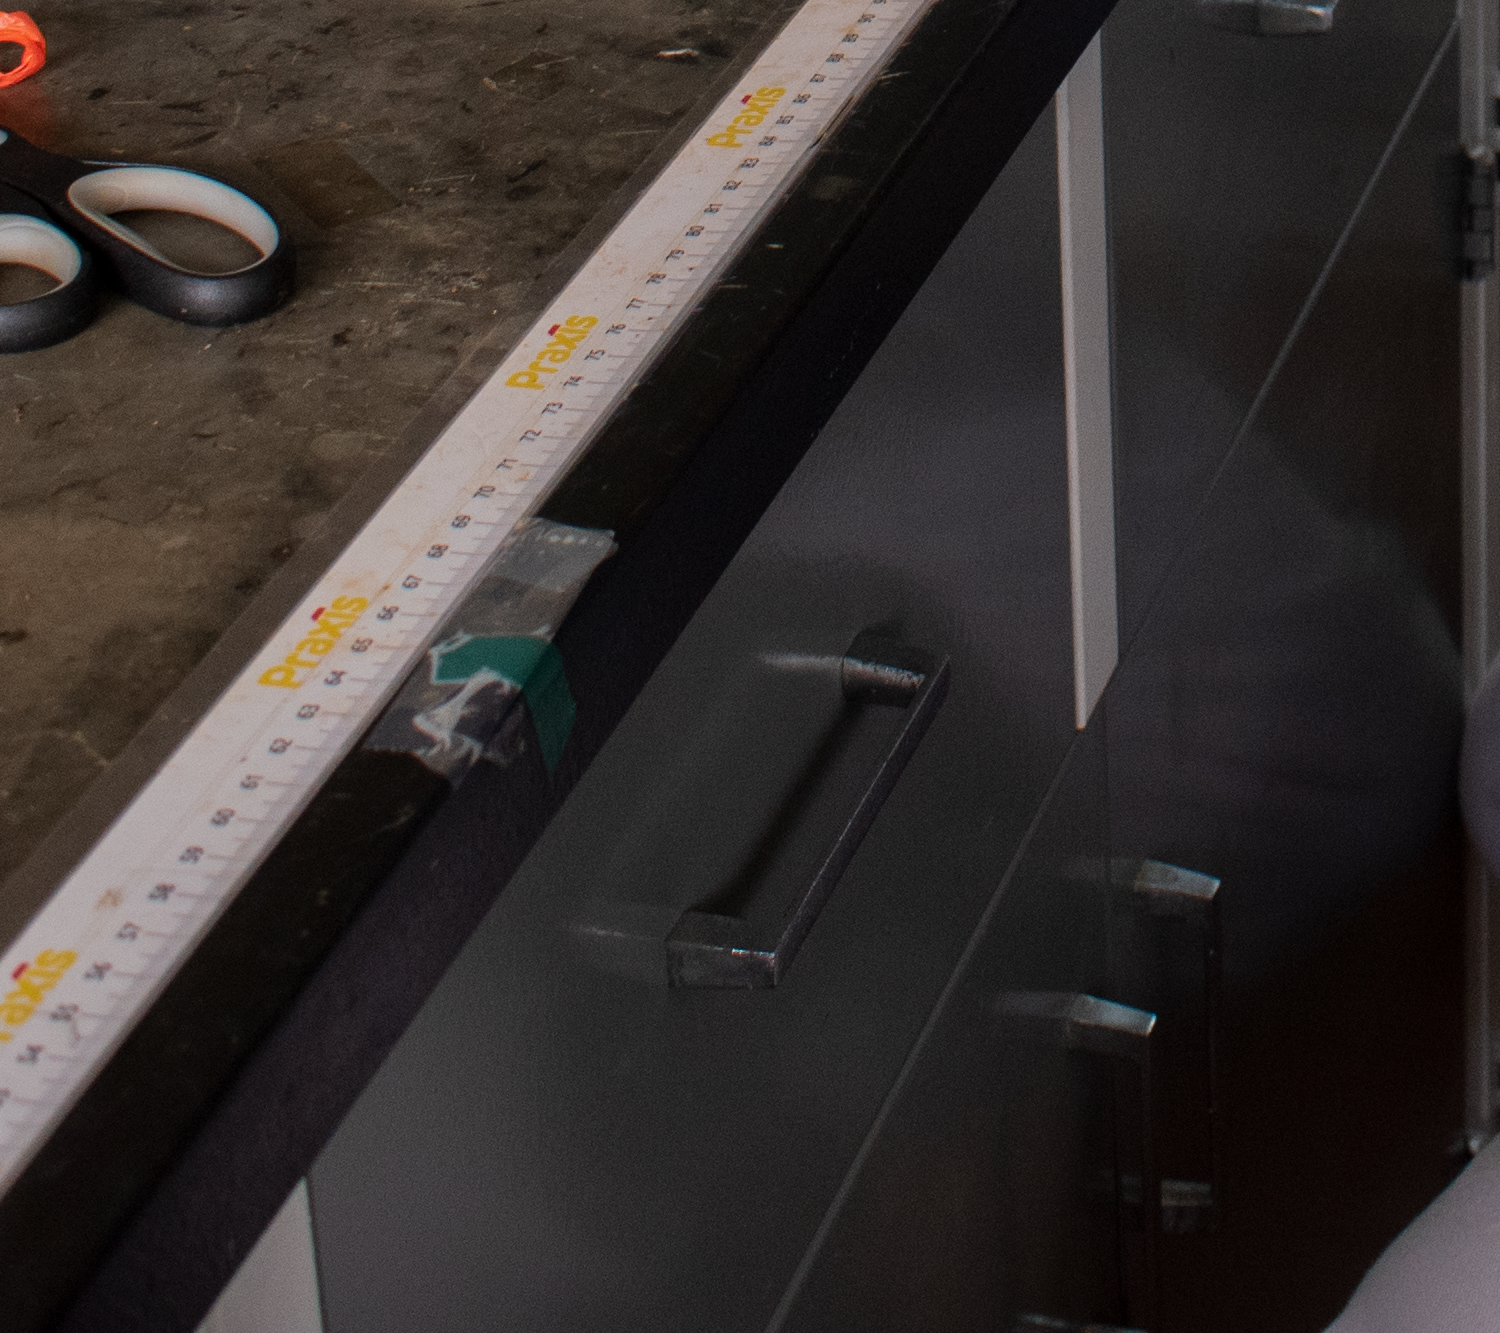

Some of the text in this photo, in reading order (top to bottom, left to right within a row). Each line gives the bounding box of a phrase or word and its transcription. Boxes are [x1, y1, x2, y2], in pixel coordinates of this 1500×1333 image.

[826, 53, 844, 63] 88
[809, 73, 826, 83] 87
[792, 93, 811, 104] 86
[705, 86, 787, 148] Praxis
[775, 114, 794, 125] 85
[758, 136, 777, 146] 84
[740, 157, 759, 169] 83
[722, 180, 742, 191] 82
[703, 203, 723, 214] 81
[685, 225, 705, 237] 80
[665, 249, 685, 262] 79
[645, 272, 667, 285] 78
[625, 297, 646, 309] 77
[605, 323, 626, 335] 76
[505, 315, 599, 391] Praxis
[584, 349, 605, 361] 75
[562, 375, 584, 387] 74
[541, 401, 563, 415] 73
[519, 429, 542, 442] 72
[495, 458, 518, 470] 71
[473, 485, 496, 499] 70
[451, 514, 471, 529] 69
[426, 544, 449, 558] 68
[402, 574, 423, 589] 67
[376, 605, 399, 621] 66
[257, 595, 369, 690] Praxis
[350, 638, 374, 653] 65
[324, 669, 347, 686] 64
[296, 703, 320, 720] 63
[268, 737, 293, 754] 62
[240, 774, 263, 790] 61
[210, 807, 236, 828] 60
[179, 845, 204, 864] 59
[147, 883, 176, 902] 58
[115, 920, 142, 941] 57
[83, 962, 112, 982] 56
